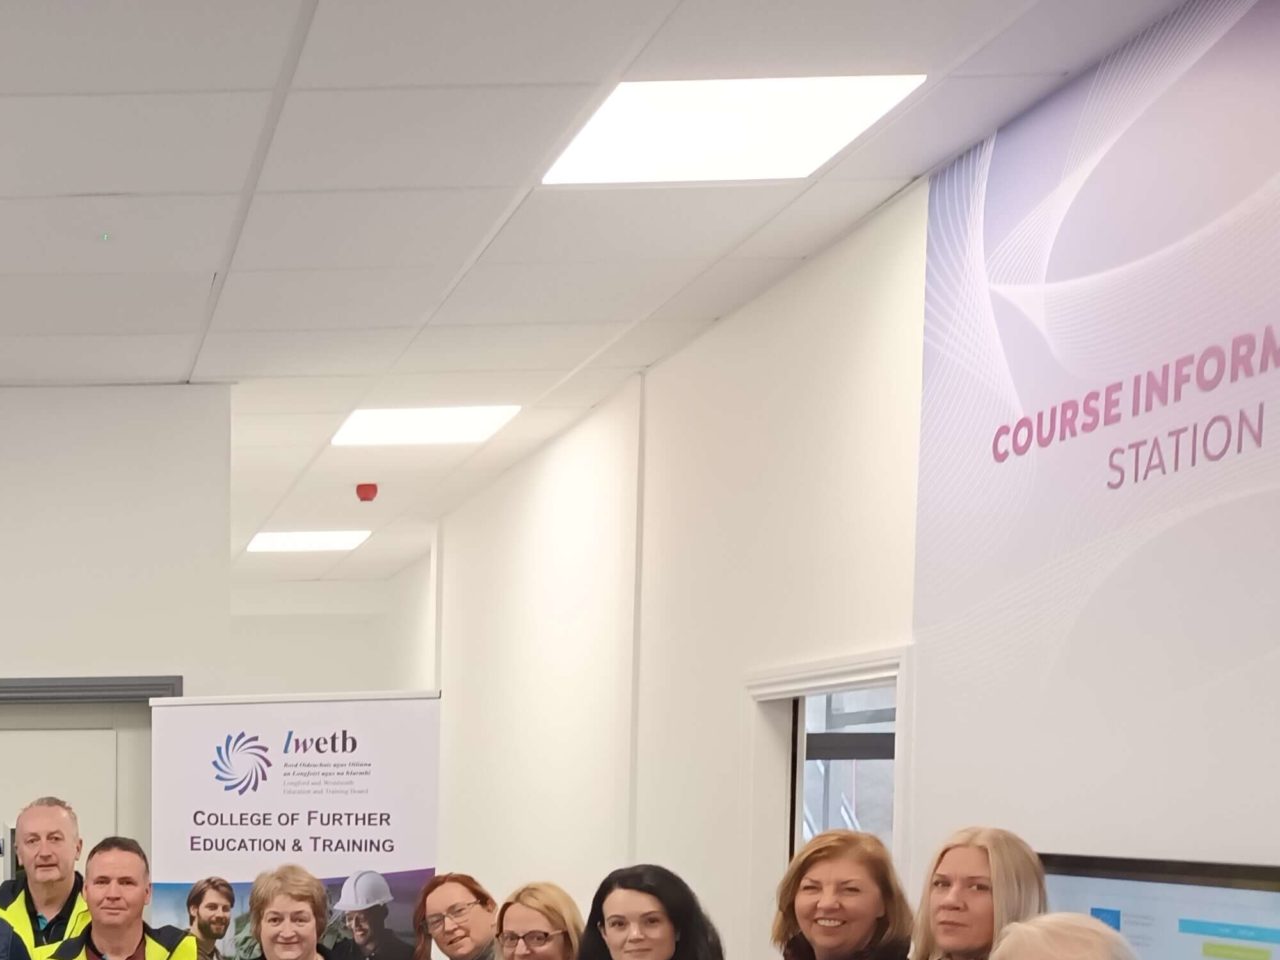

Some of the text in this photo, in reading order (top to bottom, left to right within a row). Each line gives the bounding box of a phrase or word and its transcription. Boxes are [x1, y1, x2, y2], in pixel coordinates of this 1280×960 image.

[992, 382, 1123, 463] COURSE
[1107, 401, 1264, 490] STATION
[283, 730, 357, 754] lwetb
[192, 810, 391, 827] COLLEGE OF FURTHER
[190, 836, 395, 853] EDUCATION & TRAINING
